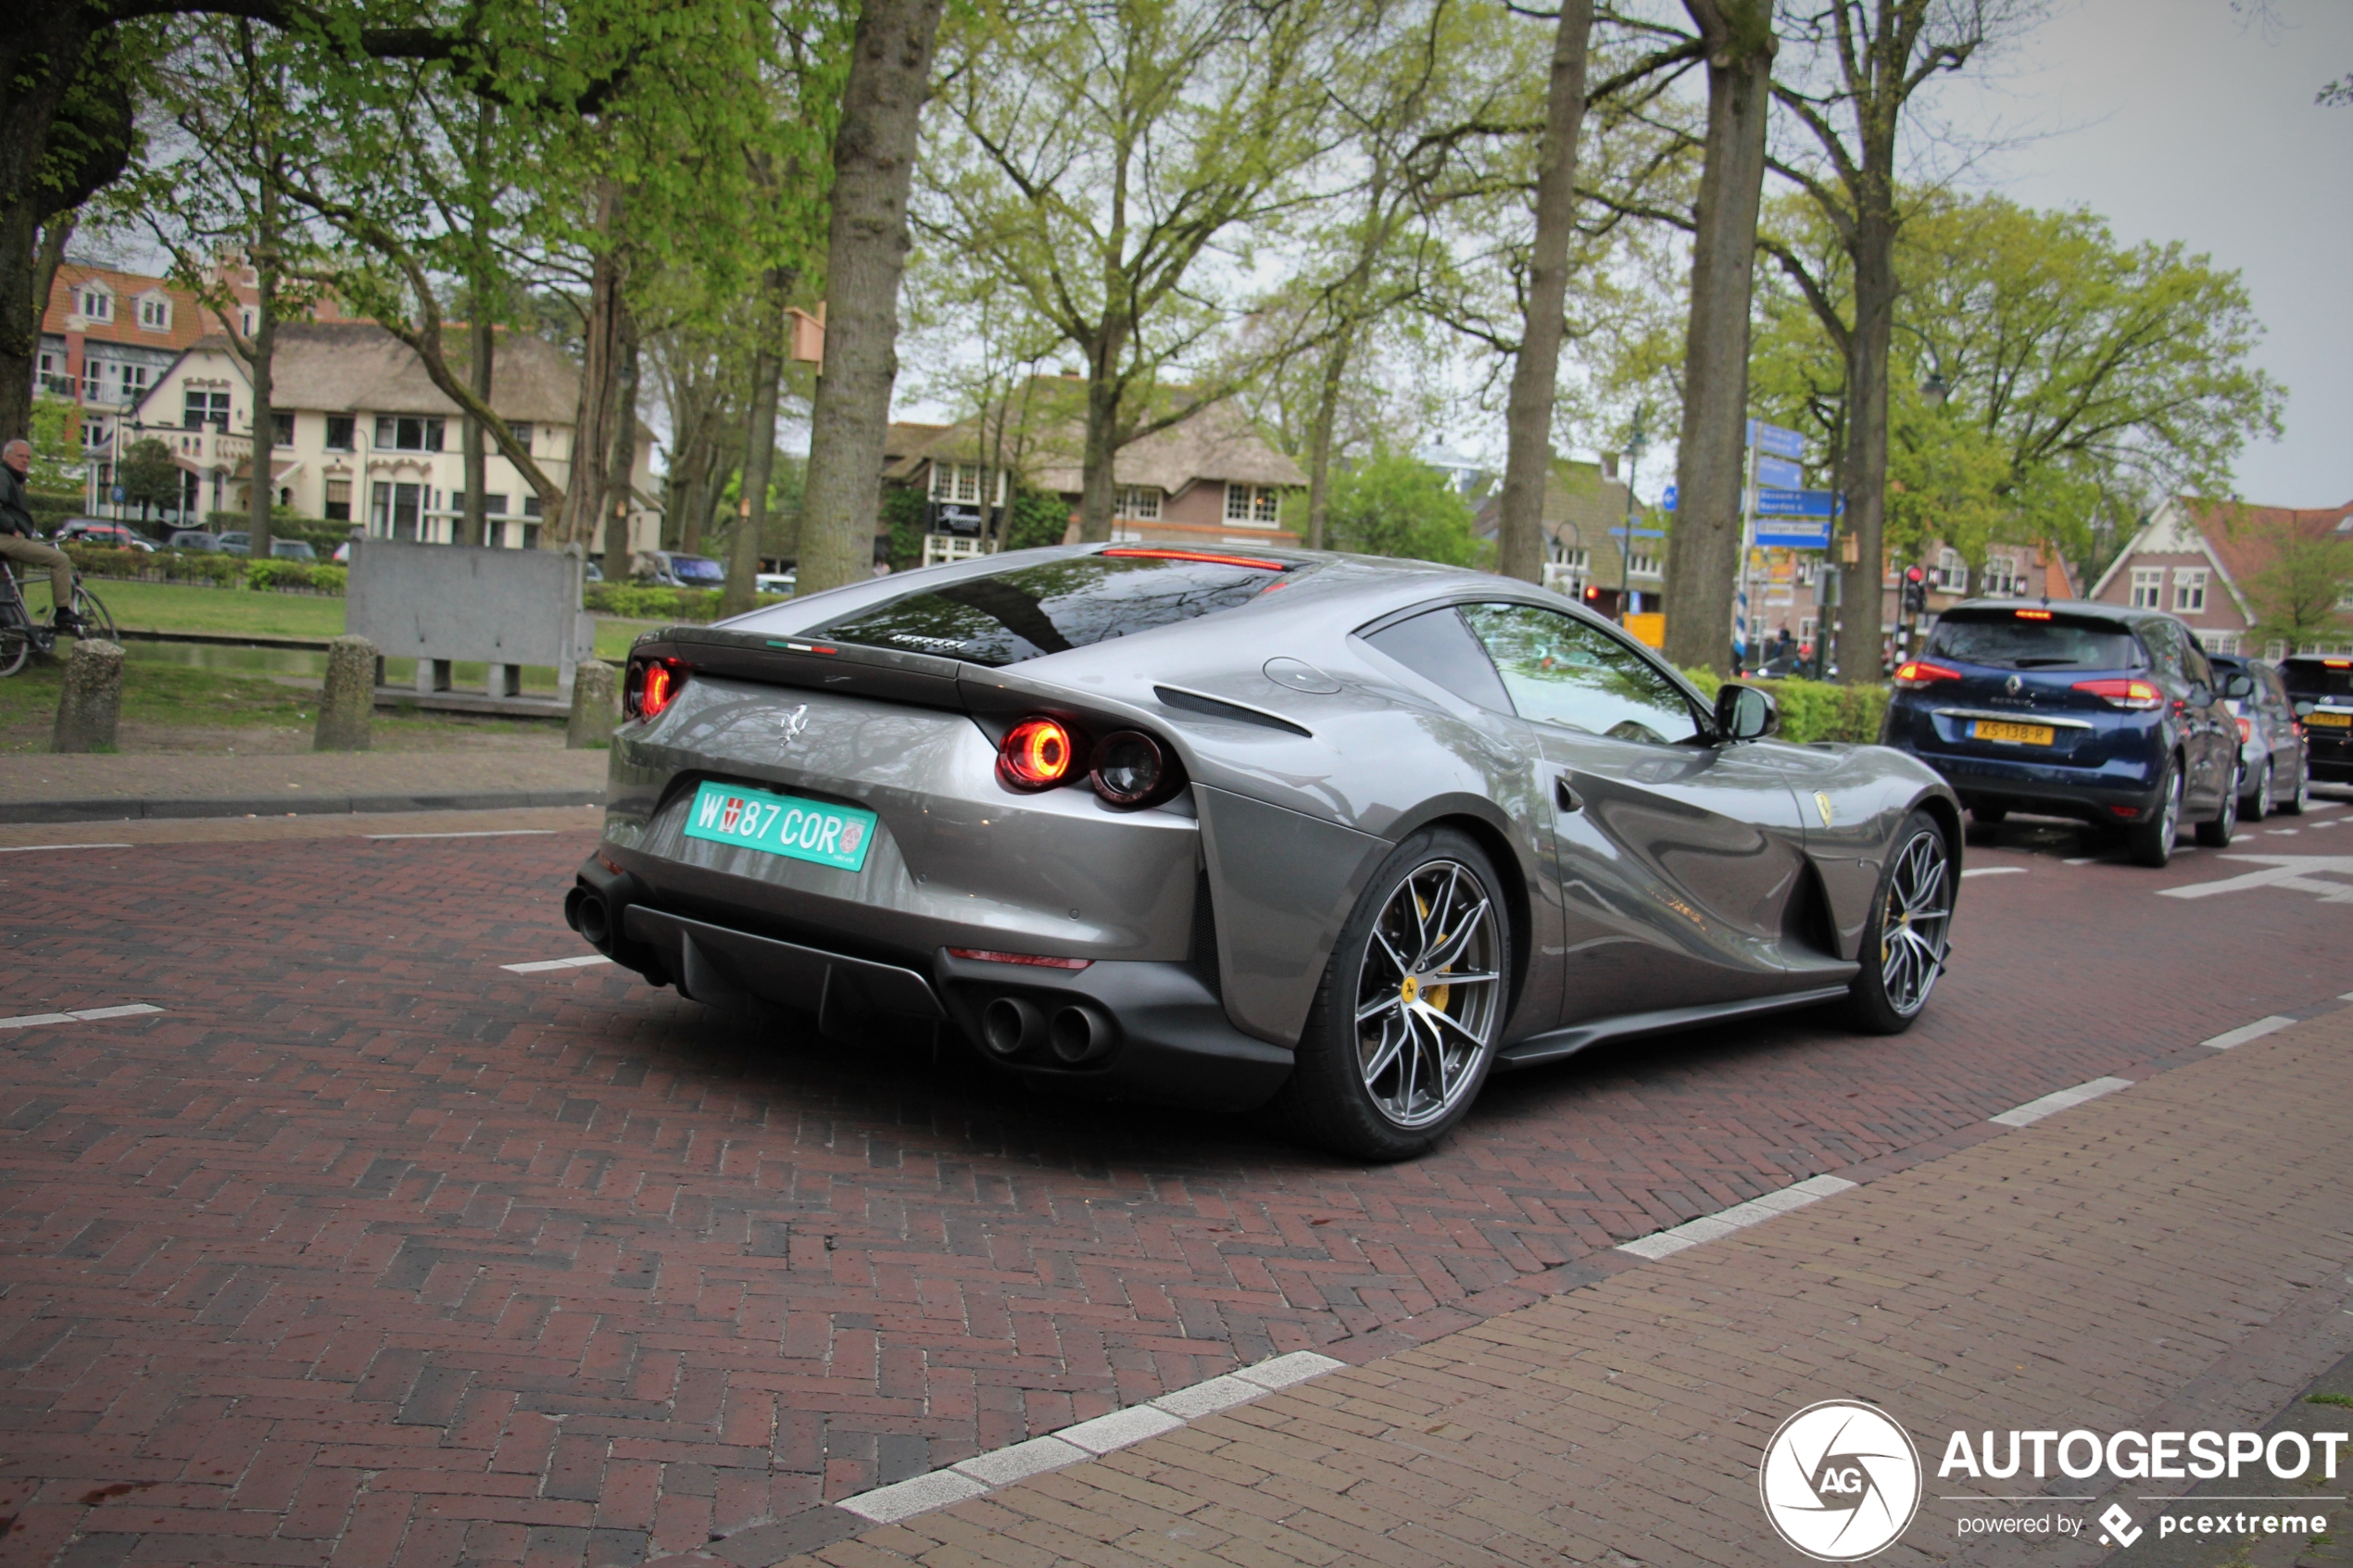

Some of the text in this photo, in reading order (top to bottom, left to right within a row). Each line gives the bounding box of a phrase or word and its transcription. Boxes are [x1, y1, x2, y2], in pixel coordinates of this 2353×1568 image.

[1980, 721, 2045, 743] XS-138-R
[698, 793, 843, 855] W 87 COR
